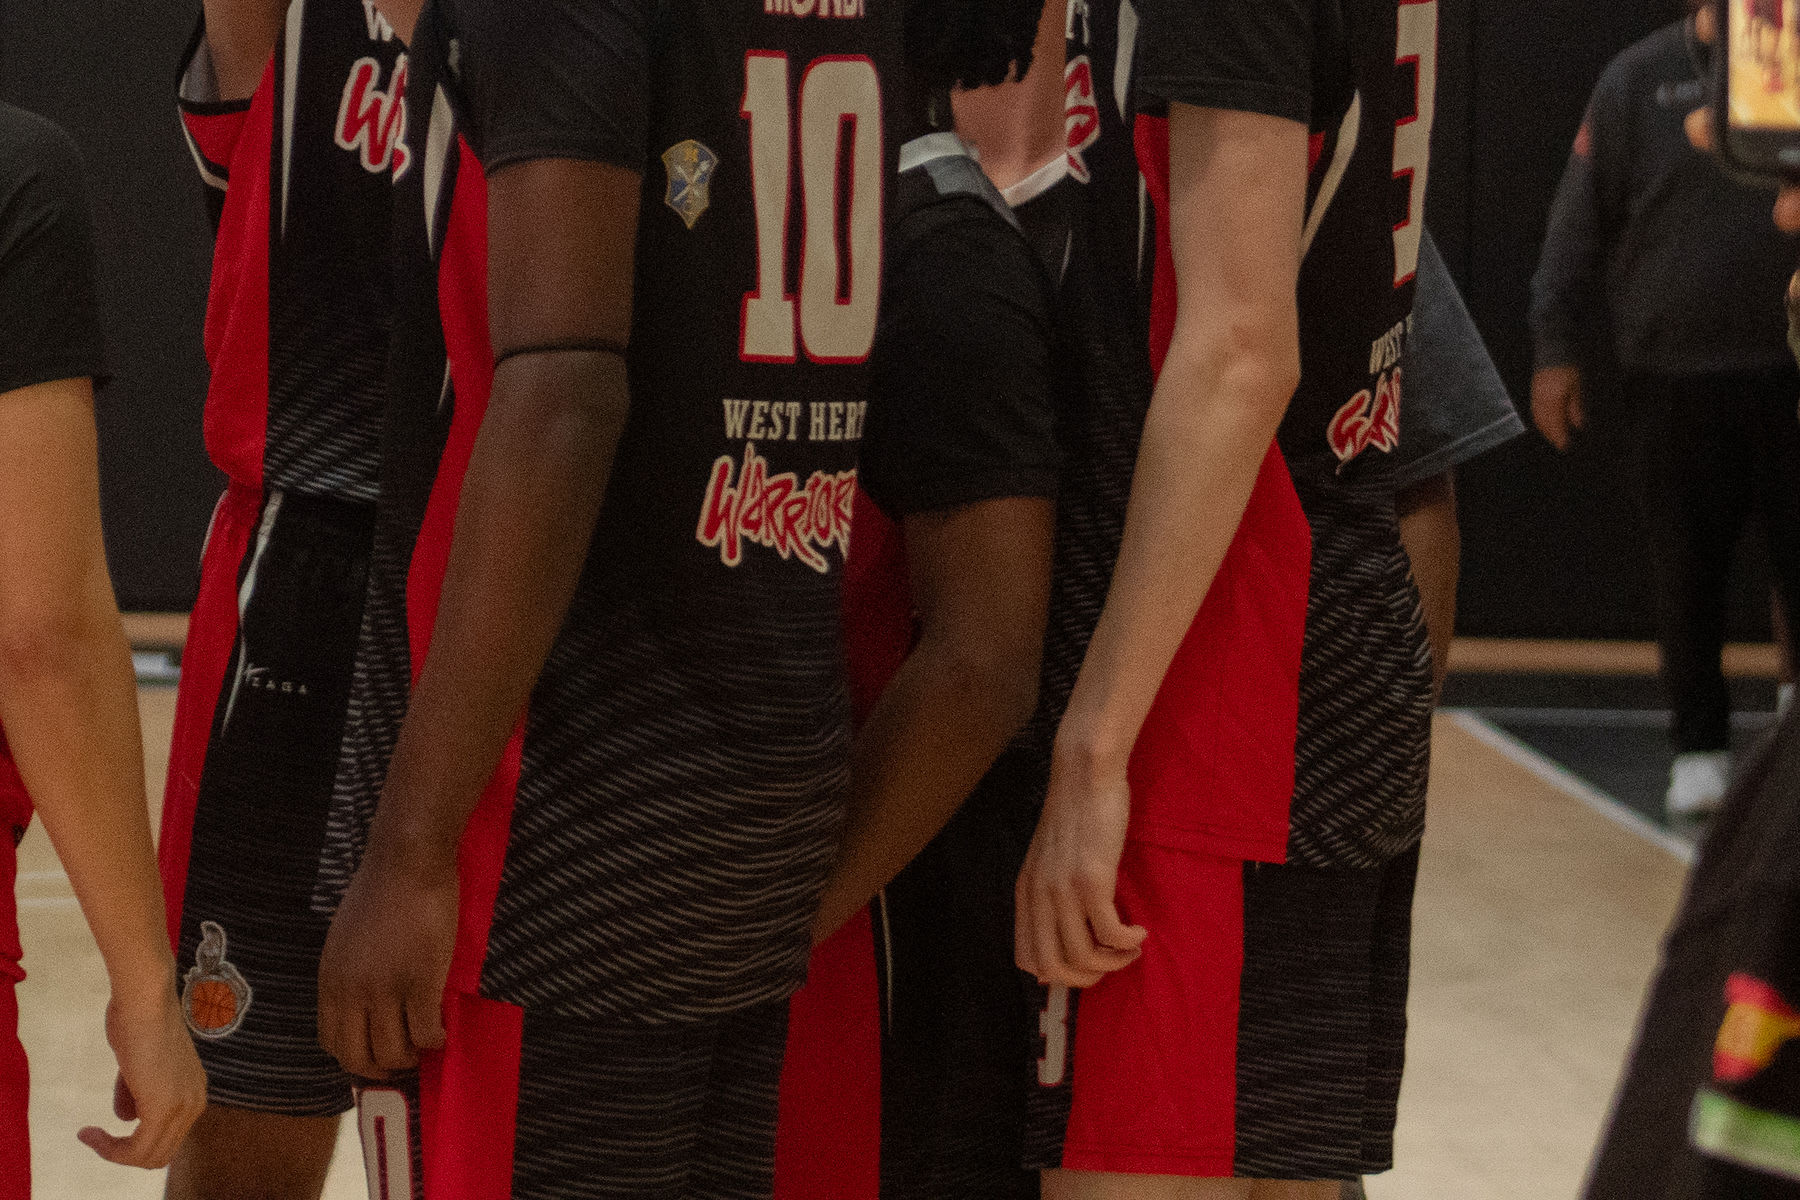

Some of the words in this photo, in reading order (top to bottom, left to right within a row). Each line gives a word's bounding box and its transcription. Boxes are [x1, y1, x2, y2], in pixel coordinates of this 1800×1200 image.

[739, 49, 884, 365] 10
[722, 399, 800, 441] WEST
[695, 438, 858, 574] WARRIOR
